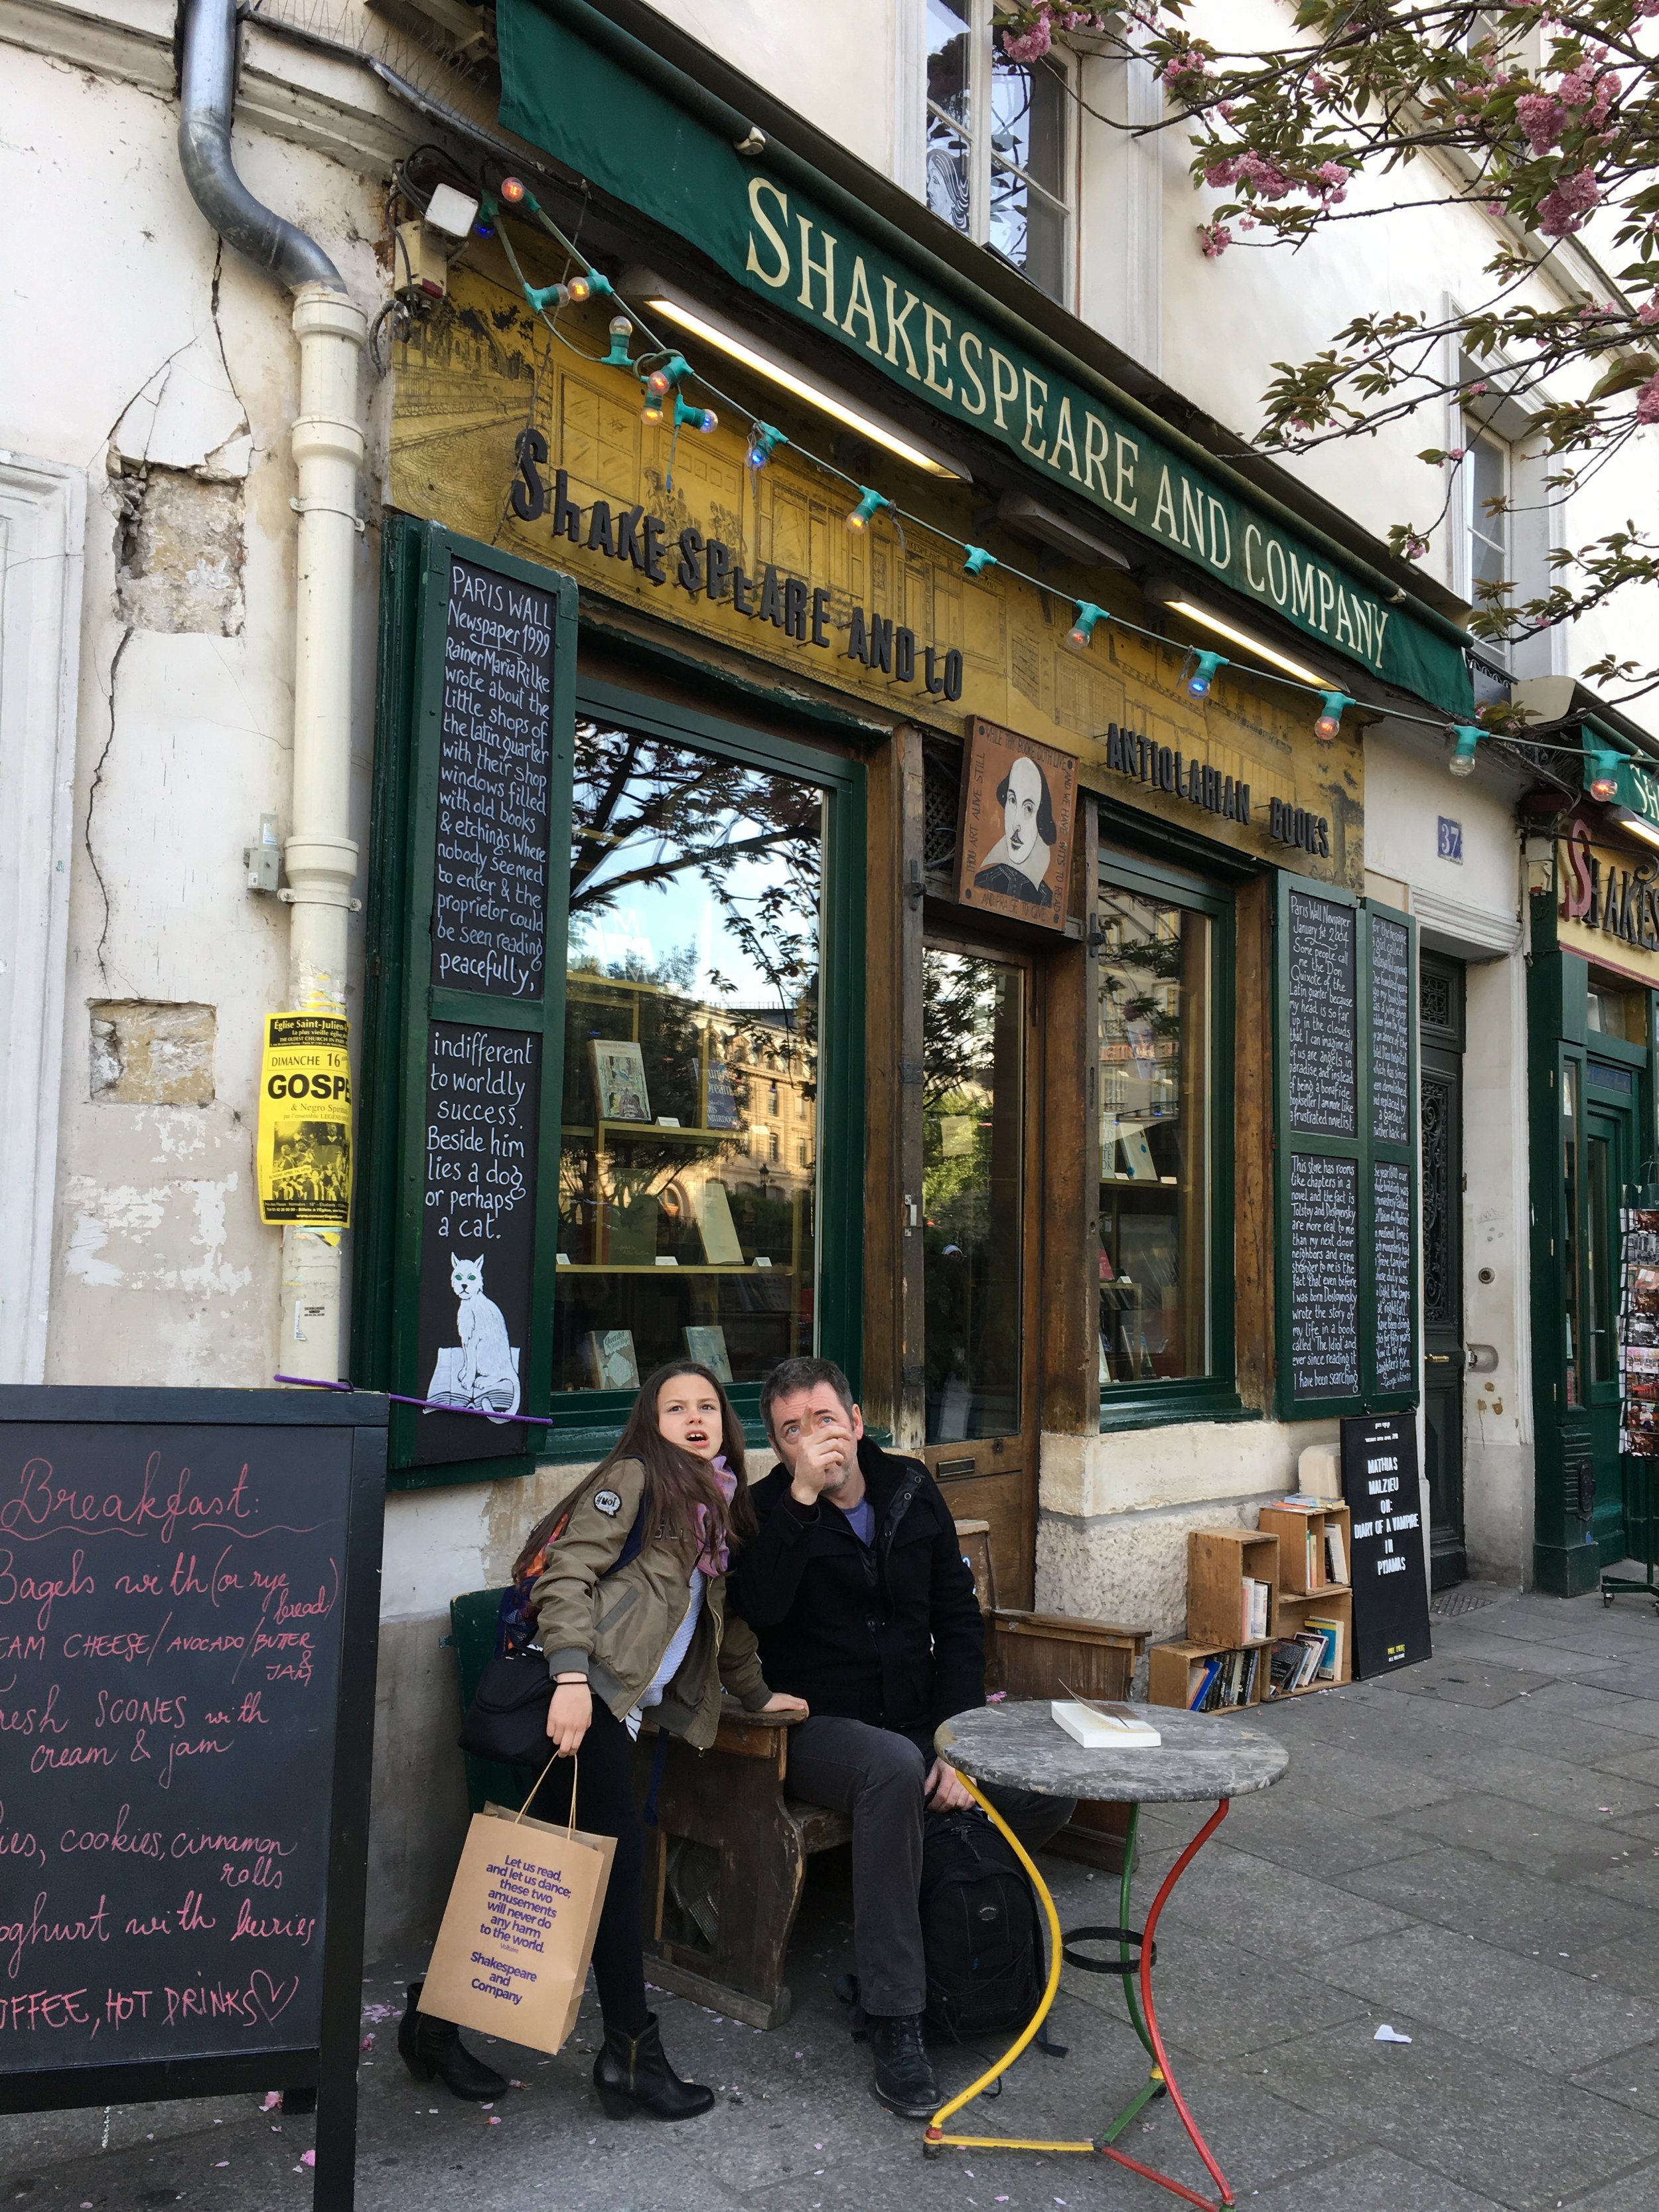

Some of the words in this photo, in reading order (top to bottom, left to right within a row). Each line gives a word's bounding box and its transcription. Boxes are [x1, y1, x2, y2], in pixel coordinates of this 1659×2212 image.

[745, 176, 1139, 517] SHAKESPEARE
[1151, 465, 1232, 571] AND
[1244, 522, 1390, 668] COMPANY
[453, 566, 502, 612] PARIS
[509, 590, 551, 630] WALL
[447, 599, 520, 648] Newspaper
[523, 625, 550, 658] 1999
[847, 607, 914, 683] AND
[446, 636, 484, 666] Rainer
[484, 649, 515, 677] Maria
[518, 660, 550, 693] Rilke
[446, 666, 484, 692] wrote
[489, 680, 524, 709] about
[529, 698, 549, 719] the
[444, 712, 467, 737] the
[502, 737, 549, 765] quarter
[489, 707, 528, 739] shops
[532, 721, 548, 750] of
[443, 739, 471, 764] with
[477, 744, 512, 776] their
[514, 765, 546, 796] shop
[975, 753, 985, 783] STILL
[441, 766, 504, 797] windows
[508, 782, 546, 816] filled
[972, 788, 981, 820] ALIVE
[440, 790, 470, 813] with
[474, 796, 494, 820] old
[501, 801, 535, 833] books
[1269, 796, 1329, 857] BOOKS
[440, 812, 452, 835] &
[513, 834, 546, 863] Where
[1441, 824, 1459, 857] 37
[438, 842, 487, 875] nobody
[490, 856, 544, 886] seemed
[438, 865, 453, 884] to
[457, 868, 496, 896] enter
[501, 878, 510, 903] &
[516, 883, 541, 909] the
[437, 893, 508, 923] proprietor
[510, 912, 543, 934] could
[1291, 896, 1308, 918] Paris
[1309, 900, 1321, 921] Wall
[1323, 905, 1350, 933] Newspaper
[437, 915, 455, 940] be
[459, 926, 492, 947] seen
[497, 931, 543, 972] reading
[1293, 917, 1317, 945] January
[1329, 928, 1349, 948] 2004
[274, 1019, 294, 1031] Église
[271, 1055, 321, 1067] DIMANCHE
[327, 1053, 340, 1068] 16
[434, 1031, 533, 1067] indifferent
[431, 1063, 448, 1091] to
[453, 1068, 525, 1106] worldly
[301, 1104, 326, 1113] Negro
[427, 1126, 486, 1152] Beside
[491, 1128, 525, 1158] him
[428, 1153, 461, 1181] lies
[469, 1163, 478, 1183] a
[486, 1159, 526, 1200] dog
[1291, 1155, 1307, 1173] This
[1308, 1157, 1322, 1174] store
[1323, 1159, 1334, 1174] has
[1336, 1164, 1354, 1176] rooms
[425, 1189, 444, 1207] or
[451, 1185, 514, 1218] perhaps
[438, 1217, 449, 1237] a
[459, 1213, 502, 1239] cat.
[1368, 1457, 1398, 1474] MATHIAS
[1368, 1477, 1399, 1495] MALZIEU
[1354, 1522, 1373, 1539] DIARY
[1375, 1520, 1383, 1534] OF
[1386, 1519, 1391, 1533] A
[1385, 1539, 1394, 1554] IN
[115, 1552, 210, 1595] with
[250, 1570, 290, 1613] rye
[96, 1690, 186, 1728] SCONES
[205, 1692, 269, 1725] with
[31, 1744, 119, 1773] cream
[130, 1729, 151, 1763] &
[159, 1734, 234, 1788] jam
[171, 1827, 298, 1858] cinnamon
[221, 1856, 283, 1889] rolls
[486, 1864, 508, 1878] and
[509, 1868, 522, 1881] let
[524, 1876, 536, 1885] us
[505, 1854, 521, 1869] Let
[523, 1862, 535, 1873] us
[538, 1866, 562, 1882] read,
[488, 1889, 557, 1918] amusements
[500, 1879, 530, 1896] these
[532, 1888, 552, 1903] two
[125, 1891, 216, 1935] with
[488, 1901, 505, 1915] will
[508, 1908, 537, 1923] never
[538, 1917, 551, 1929] do
[490, 1915, 512, 1930] any
[513, 1920, 541, 1939] harm
[480, 1923, 492, 1935] to
[493, 1925, 511, 1942] the
[512, 1935, 545, 1954] world.
[470, 1951, 538, 1982] Shakespeare
[489, 1972, 511, 1986] and
[107, 1988, 153, 2031] HOT
[162, 1971, 257, 2026] DRINKS
[471, 1978, 522, 2006] Company
